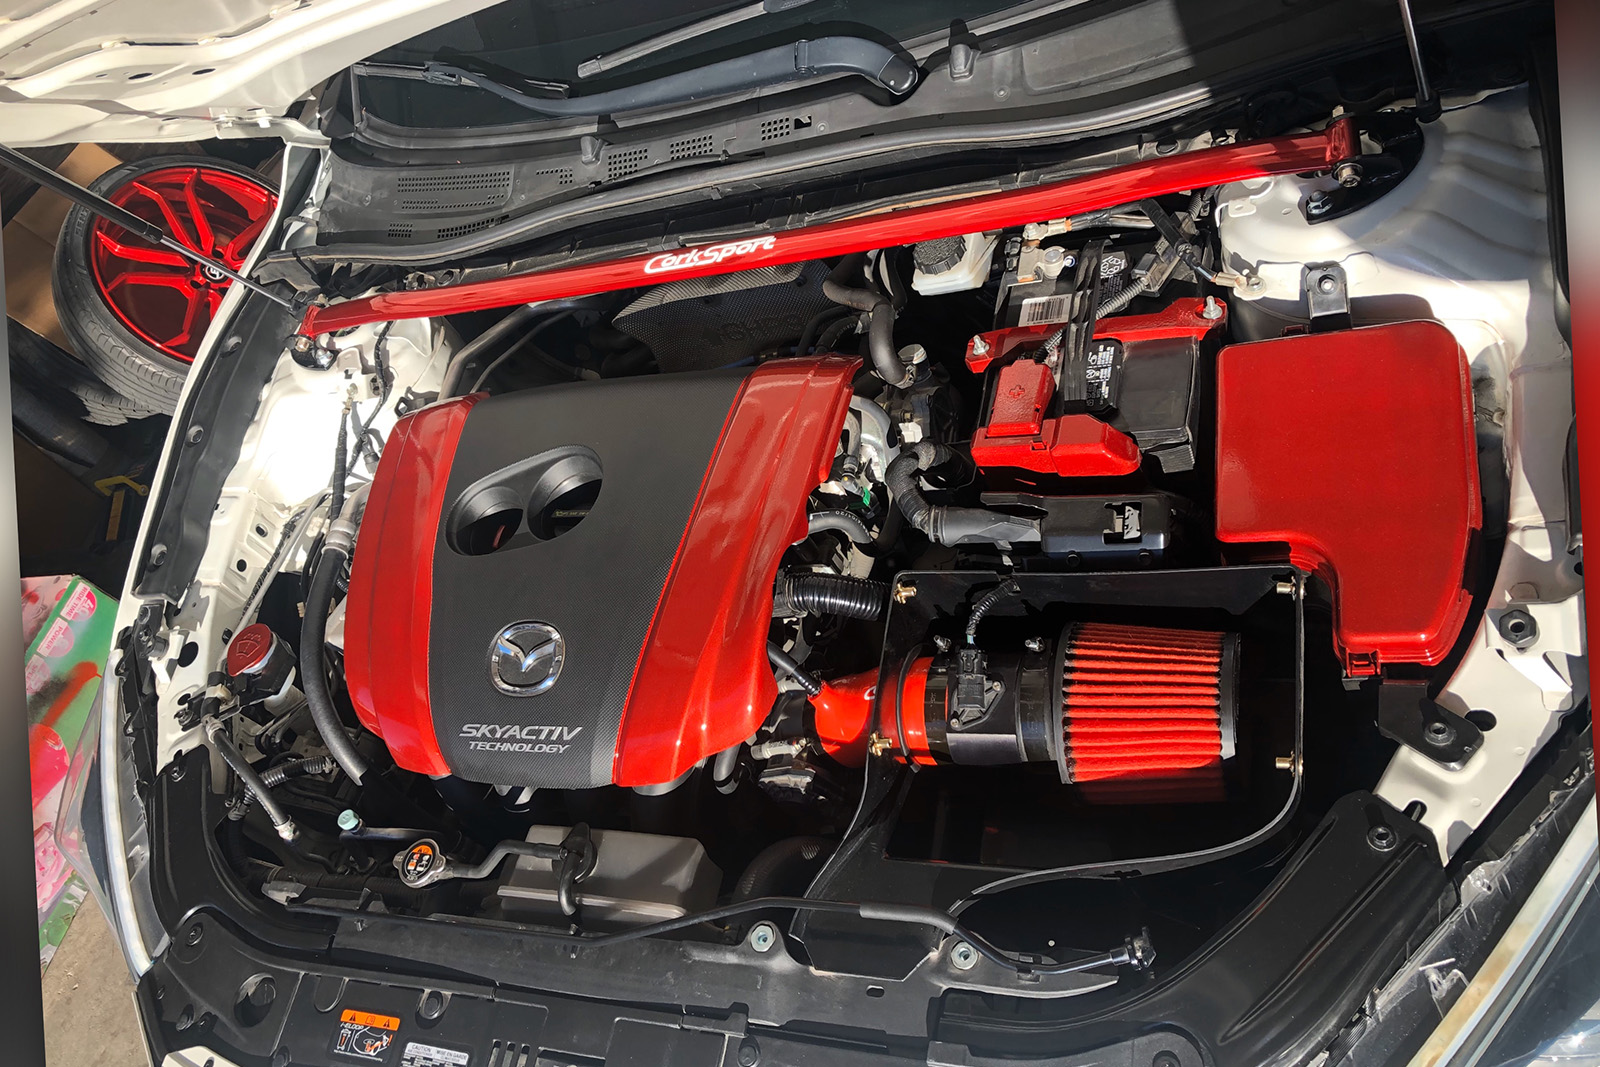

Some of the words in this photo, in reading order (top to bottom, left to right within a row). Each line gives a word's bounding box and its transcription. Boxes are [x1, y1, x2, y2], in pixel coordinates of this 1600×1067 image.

[644, 235, 776, 274] CorkSport
[75, 586, 88, 601] RIDE
[66, 602, 78, 617] TIME
[45, 626, 63, 650] POWER
[459, 723, 583, 741] SKYACTIV
[469, 740, 570, 754] TECHNOLOGY
